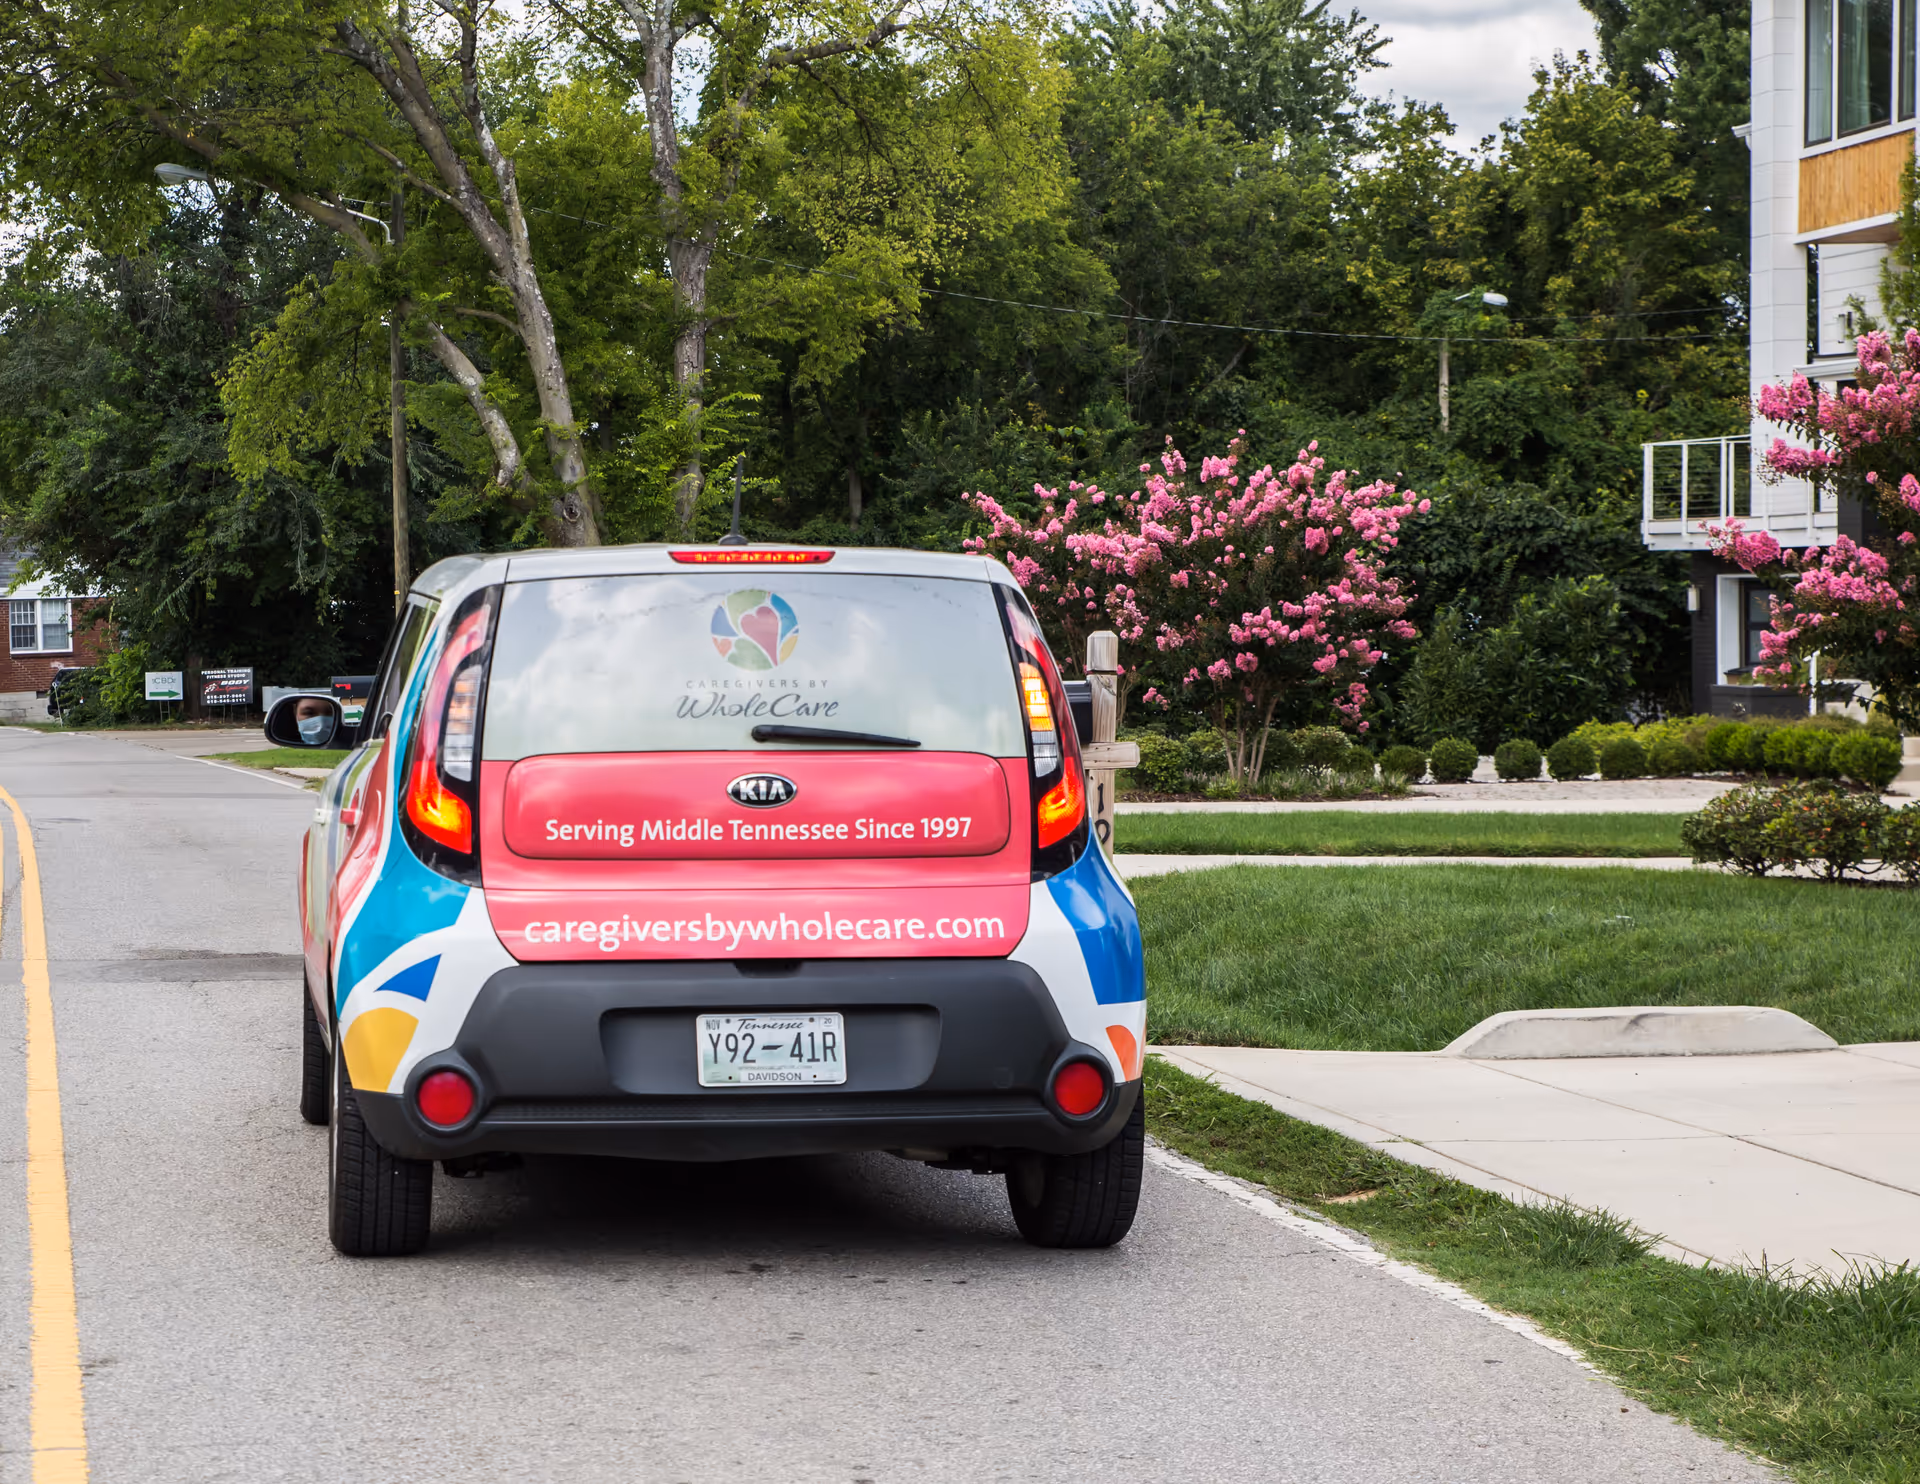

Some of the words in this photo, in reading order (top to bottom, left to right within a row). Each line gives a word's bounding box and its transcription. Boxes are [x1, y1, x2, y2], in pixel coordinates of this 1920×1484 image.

[686, 679, 799, 689] CAREGIVERS
[809, 679, 828, 688] BY
[676, 691, 840, 719] WholeCare
[738, 779, 787, 801] KIA
[545, 819, 635, 847] Serving
[641, 818, 724, 841] Middle
[728, 819, 849, 841] Tennessee
[854, 817, 915, 839] Since
[920, 816, 973, 838] 1997
[523, 911, 1006, 952] caregiversbywholecare.com
[705, 1019, 721, 1031] NOV
[737, 1018, 804, 1032] Tennessee
[823, 1017, 833, 1025] 20
[747, 1072, 802, 1081] DAVIDSON
